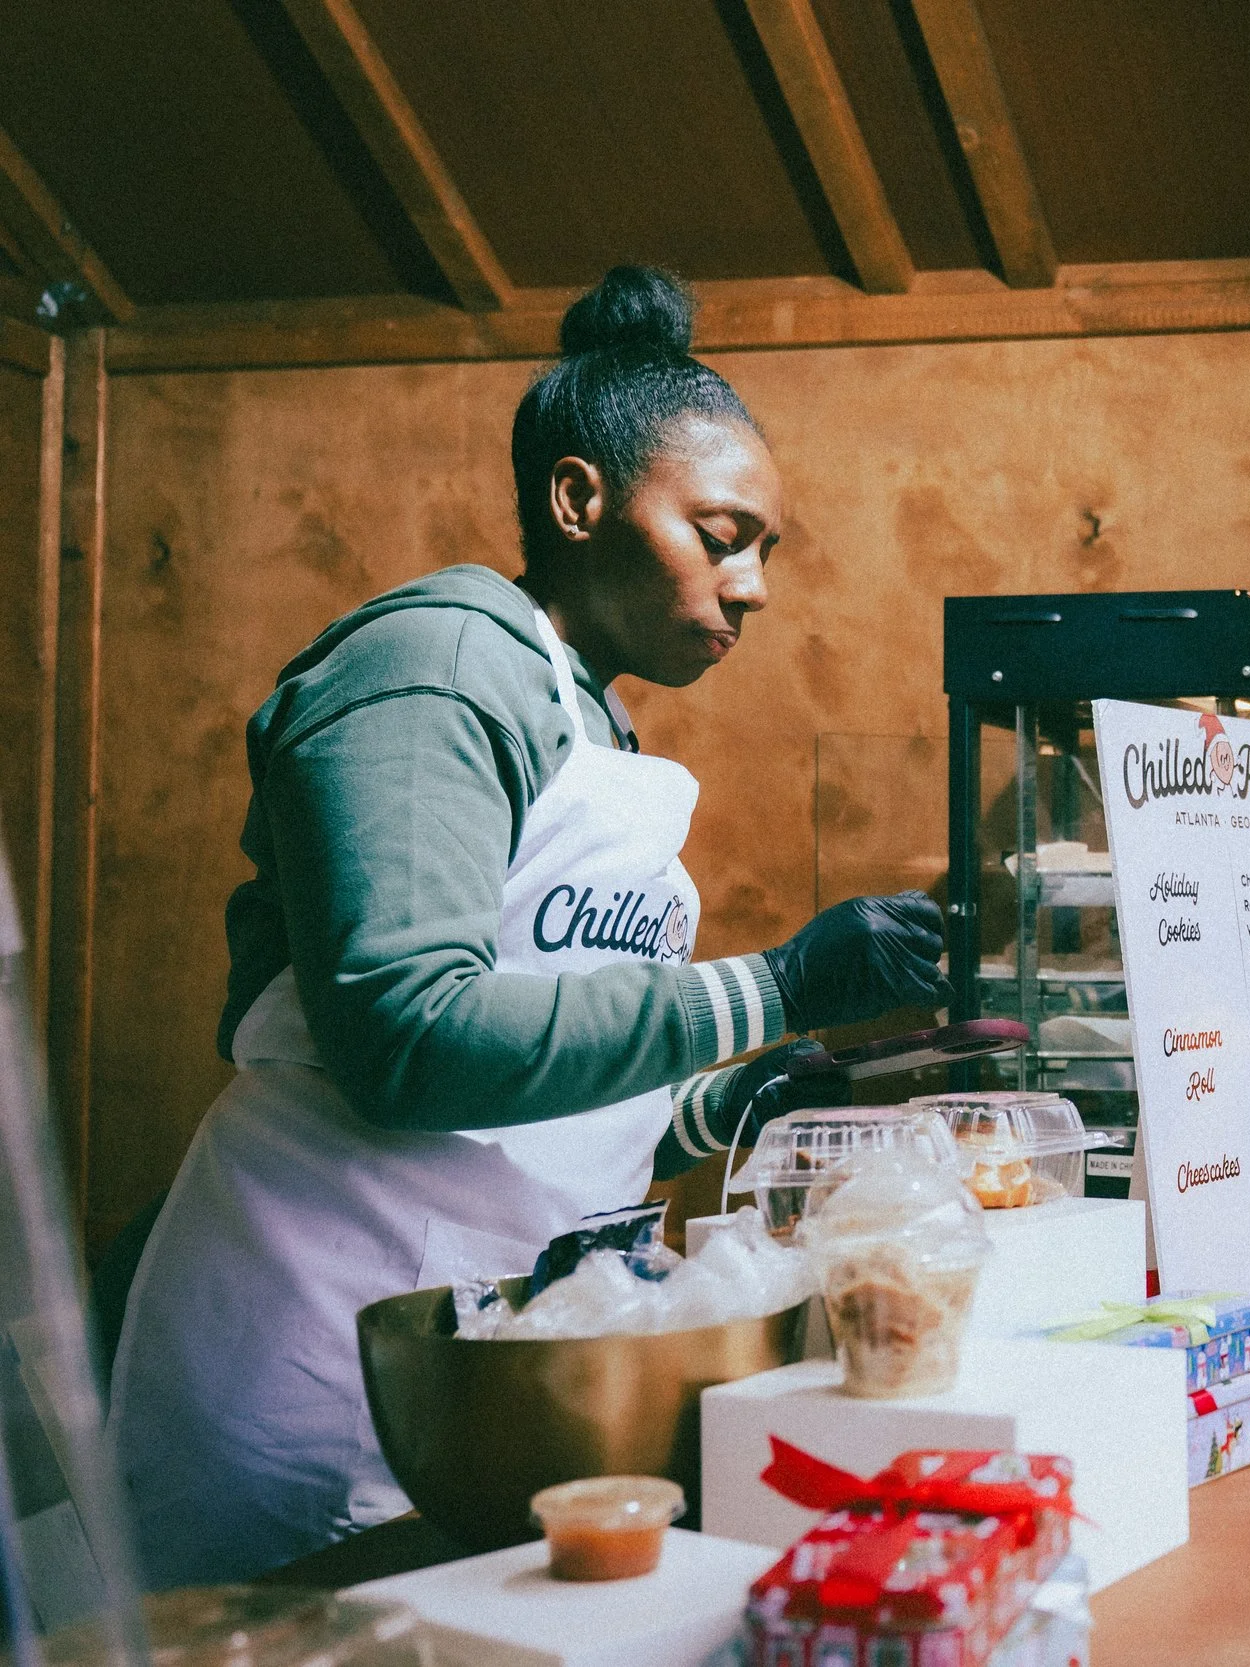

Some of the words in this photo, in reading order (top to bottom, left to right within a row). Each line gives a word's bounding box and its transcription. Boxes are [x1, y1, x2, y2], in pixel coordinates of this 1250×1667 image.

[1123, 739, 1212, 809] Chilled
[1175, 811, 1220, 827] ATLANTA
[1150, 872, 1199, 905] Holiday
[533, 884, 672, 959] Chilled
[1158, 917, 1201, 946] Cookies
[1163, 1028, 1223, 1057] Cinnamon
[1186, 1068, 1215, 1101] Roll
[1090, 1161, 1108, 1170] MADE
[1110, 1162, 1117, 1170] IN
[1177, 1153, 1241, 1194] Cheescakes
